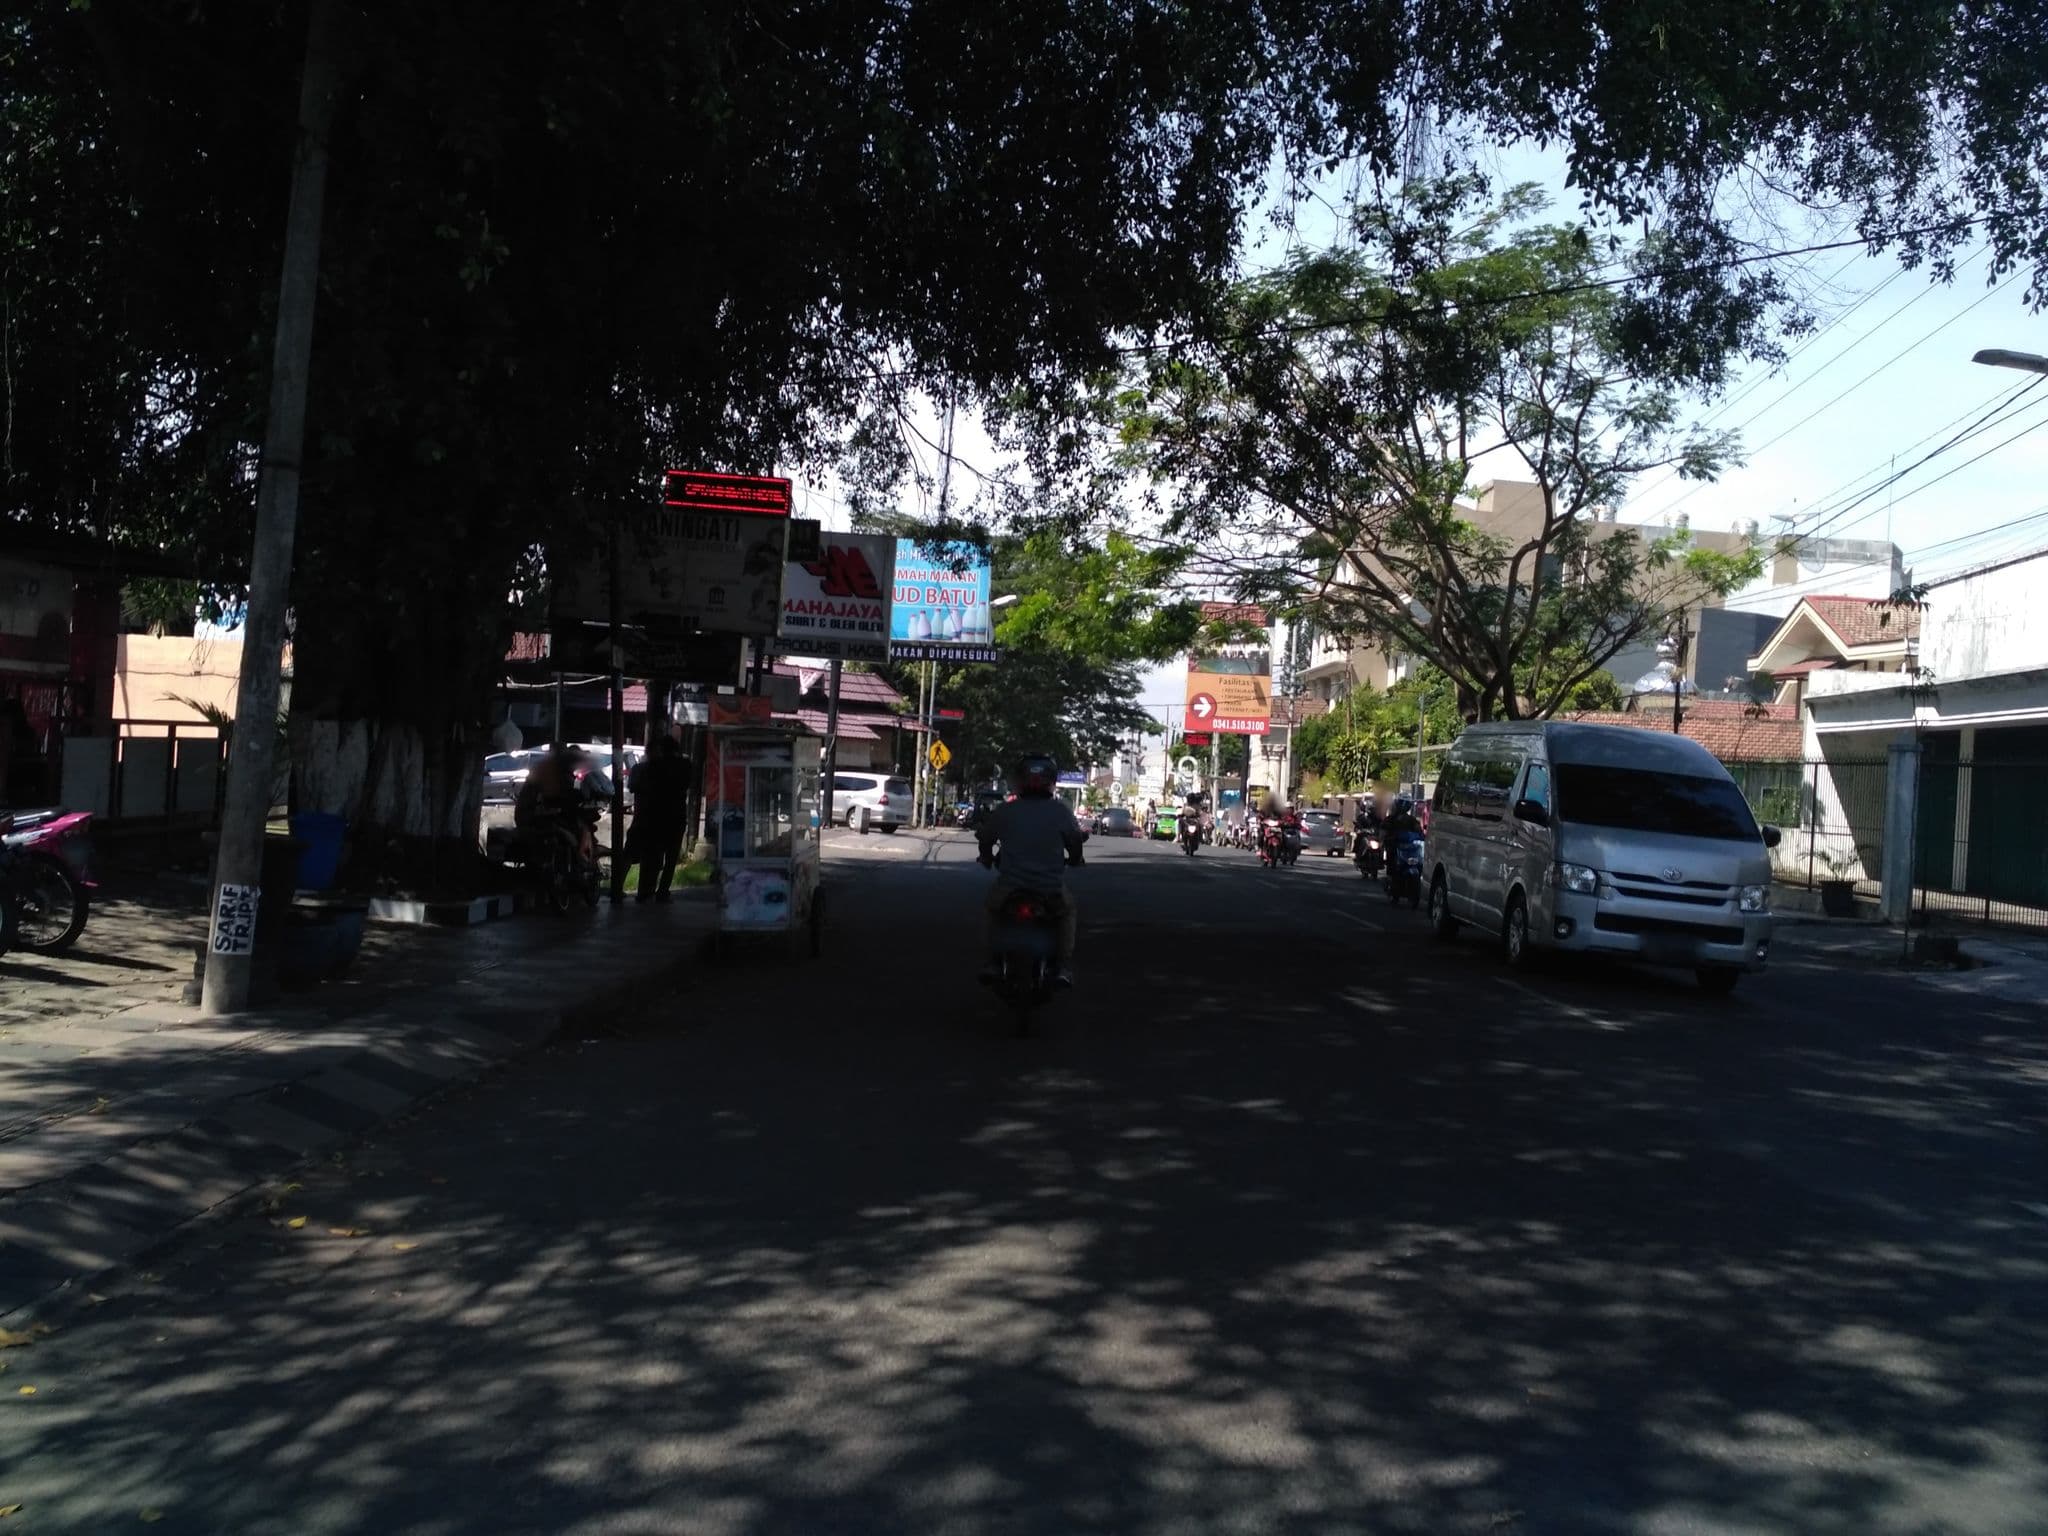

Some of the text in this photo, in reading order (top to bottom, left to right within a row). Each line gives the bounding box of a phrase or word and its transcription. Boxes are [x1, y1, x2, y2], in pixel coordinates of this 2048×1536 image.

[930, 570, 977, 583] MAKAN
[926, 587, 976, 606] BATU
[214, 886, 238, 951] SARAF
